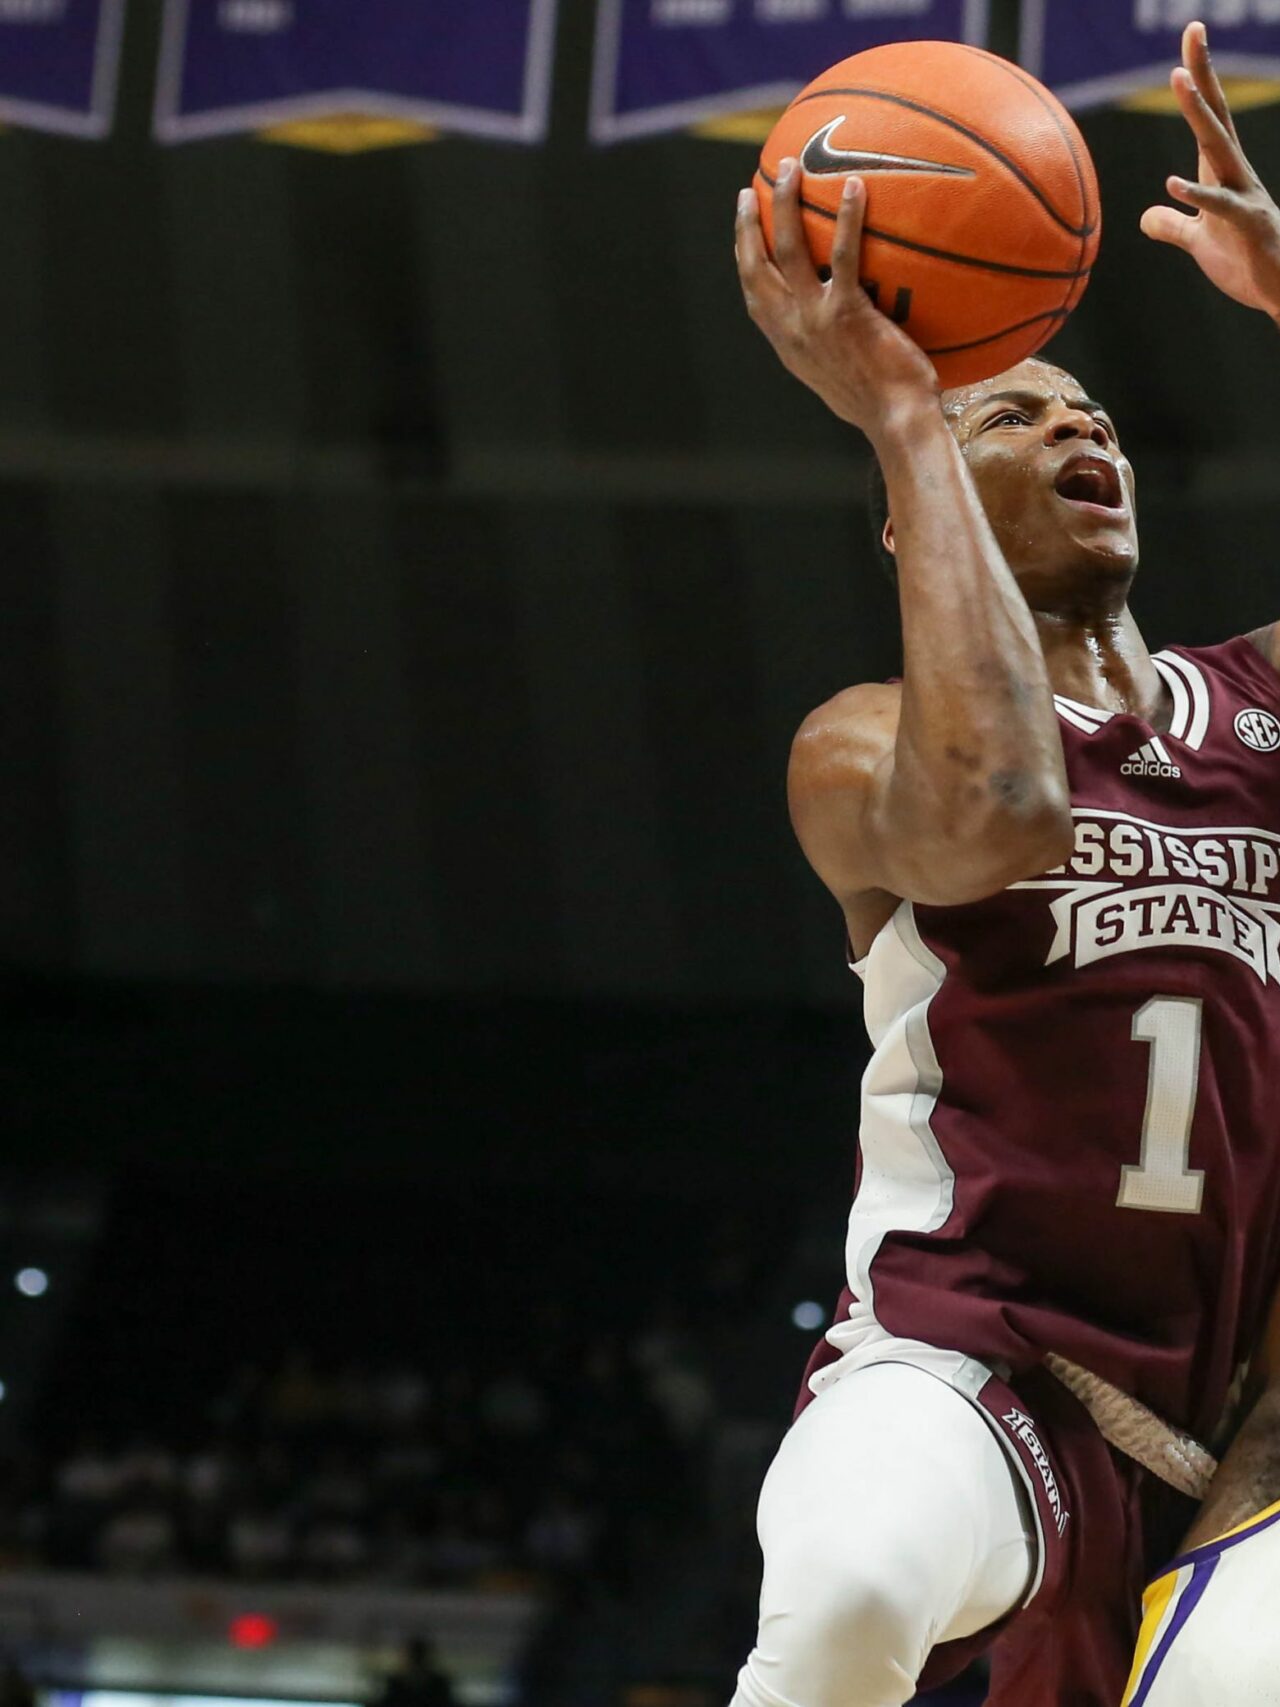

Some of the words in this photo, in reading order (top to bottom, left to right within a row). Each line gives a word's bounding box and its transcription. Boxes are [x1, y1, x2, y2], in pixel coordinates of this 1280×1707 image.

[1238, 712, 1279, 748] SEC
[1120, 761, 1181, 778] adidas
[1095, 894, 1255, 959] STATE
[1116, 994, 1205, 1214] 1
